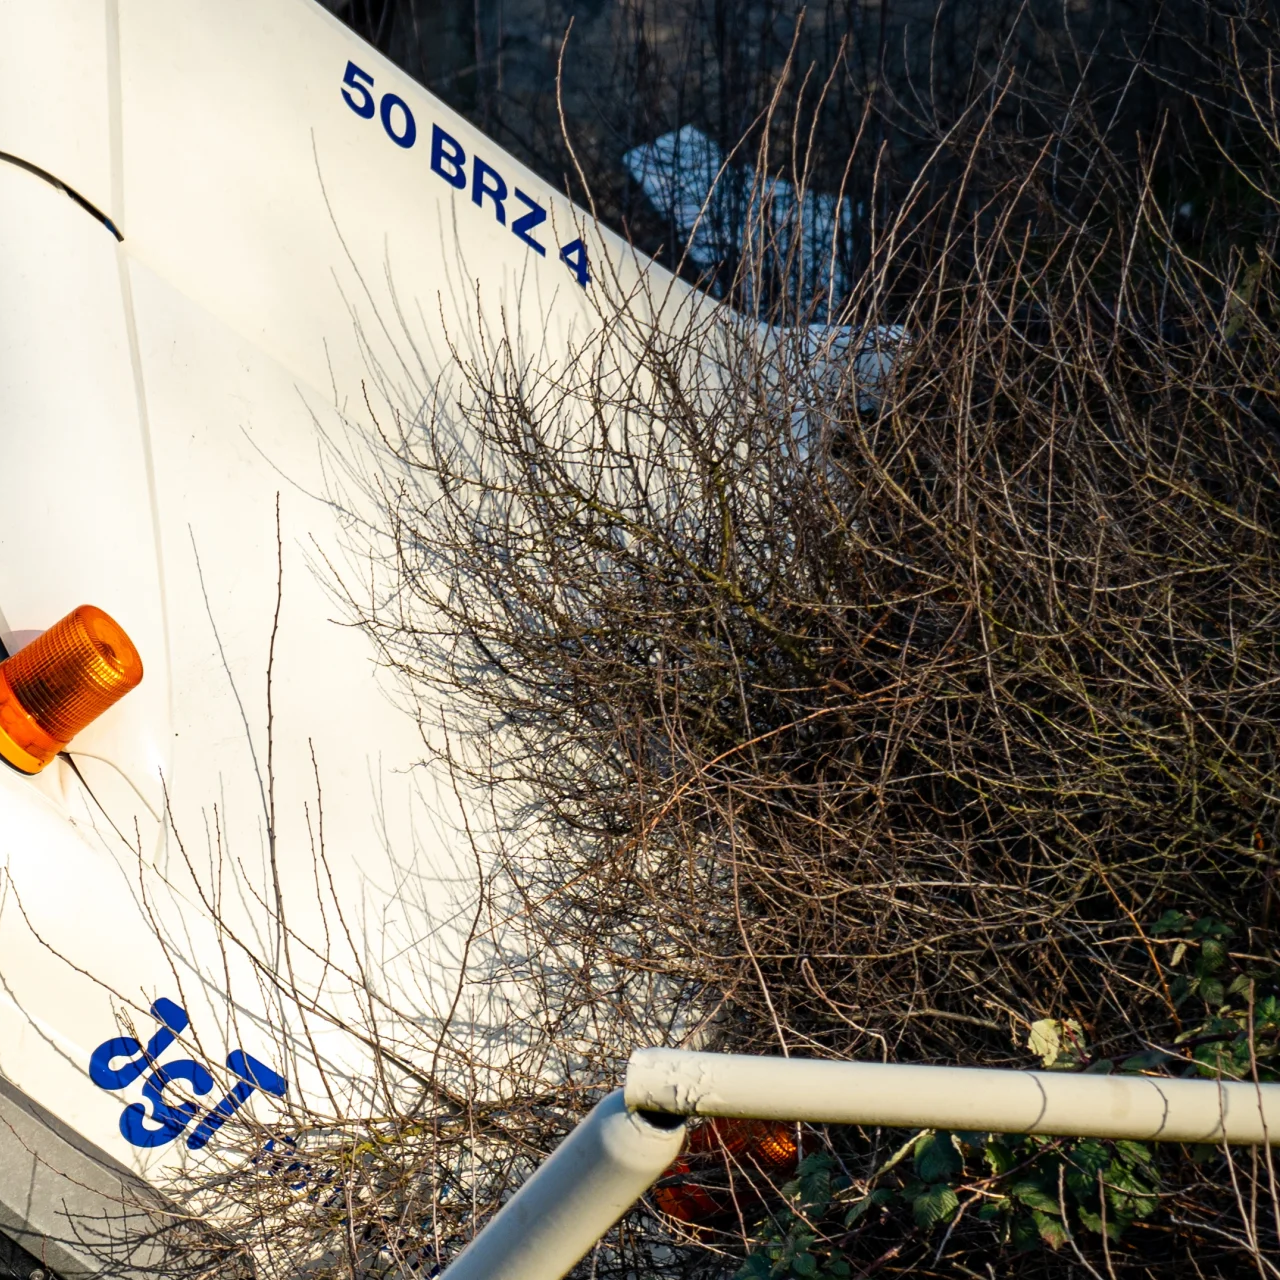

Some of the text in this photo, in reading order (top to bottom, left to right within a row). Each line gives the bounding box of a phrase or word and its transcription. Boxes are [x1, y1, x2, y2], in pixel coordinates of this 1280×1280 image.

[340, 60, 593, 290] 50 BRZ 4
